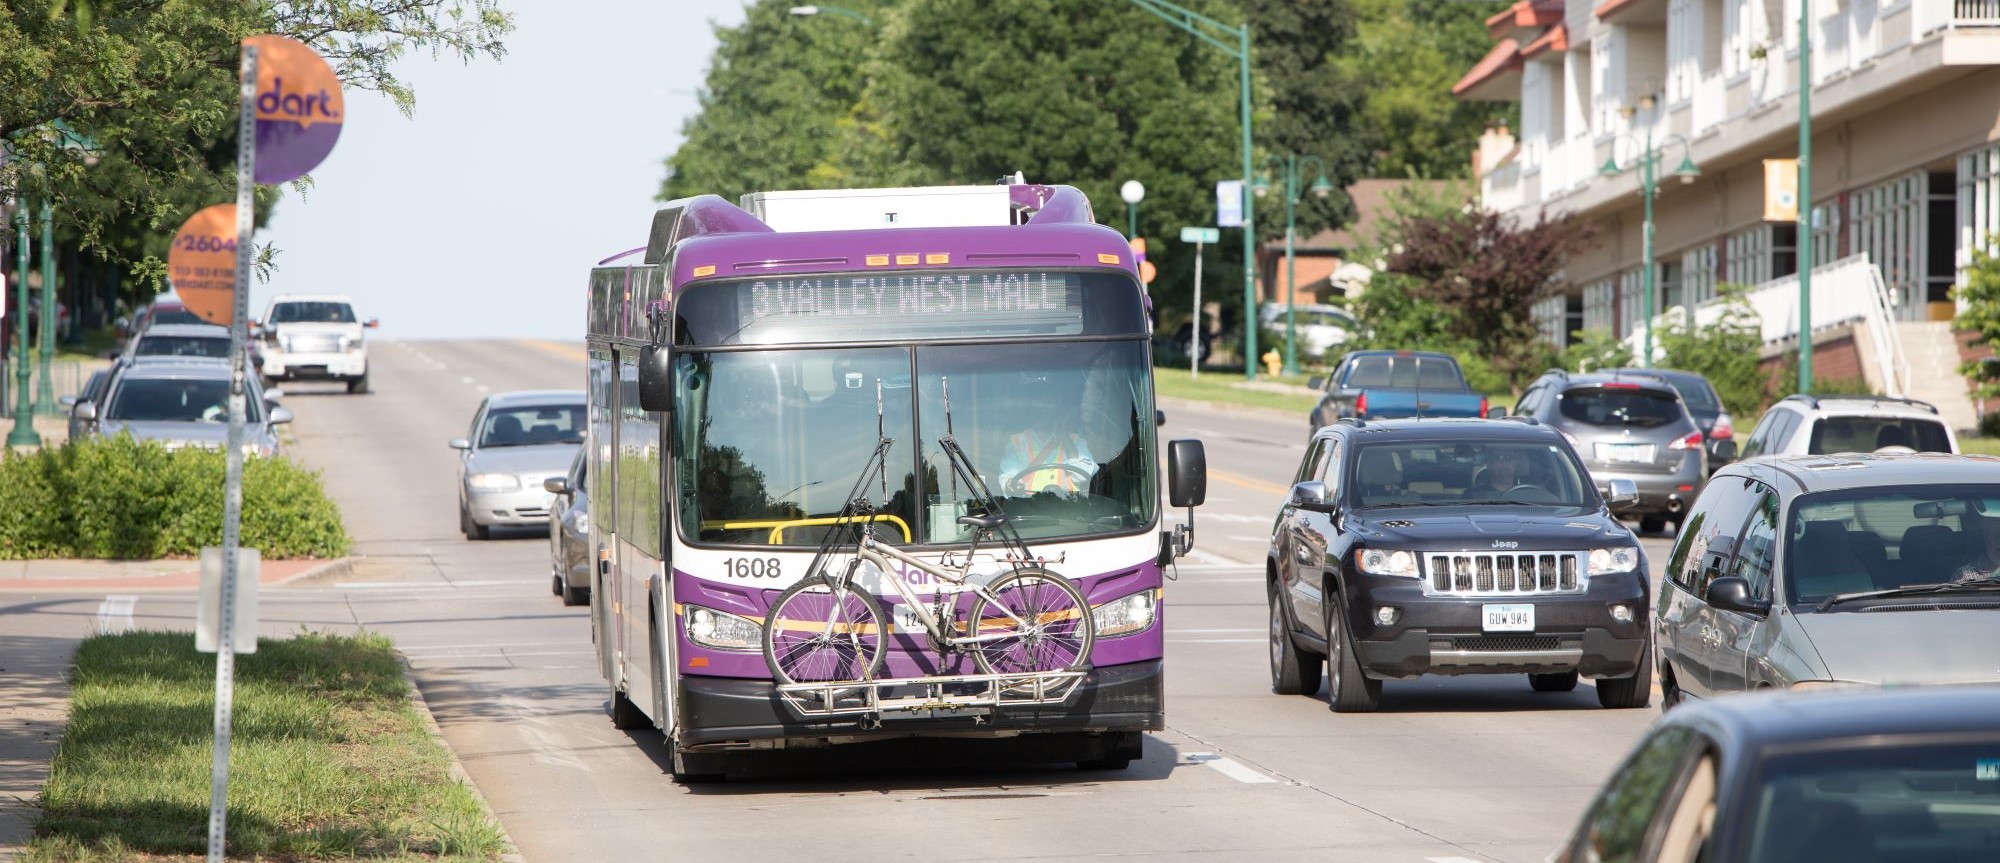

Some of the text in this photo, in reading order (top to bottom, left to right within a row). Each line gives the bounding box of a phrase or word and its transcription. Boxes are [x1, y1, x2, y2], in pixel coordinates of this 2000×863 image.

[777, 278, 886, 317] VALLEY
[899, 275, 970, 314] WEST
[983, 273, 1057, 311] MALL
[1491, 540, 1518, 549] Jeep
[723, 557, 782, 578] 1608
[1489, 612, 1528, 625] GUW 904
